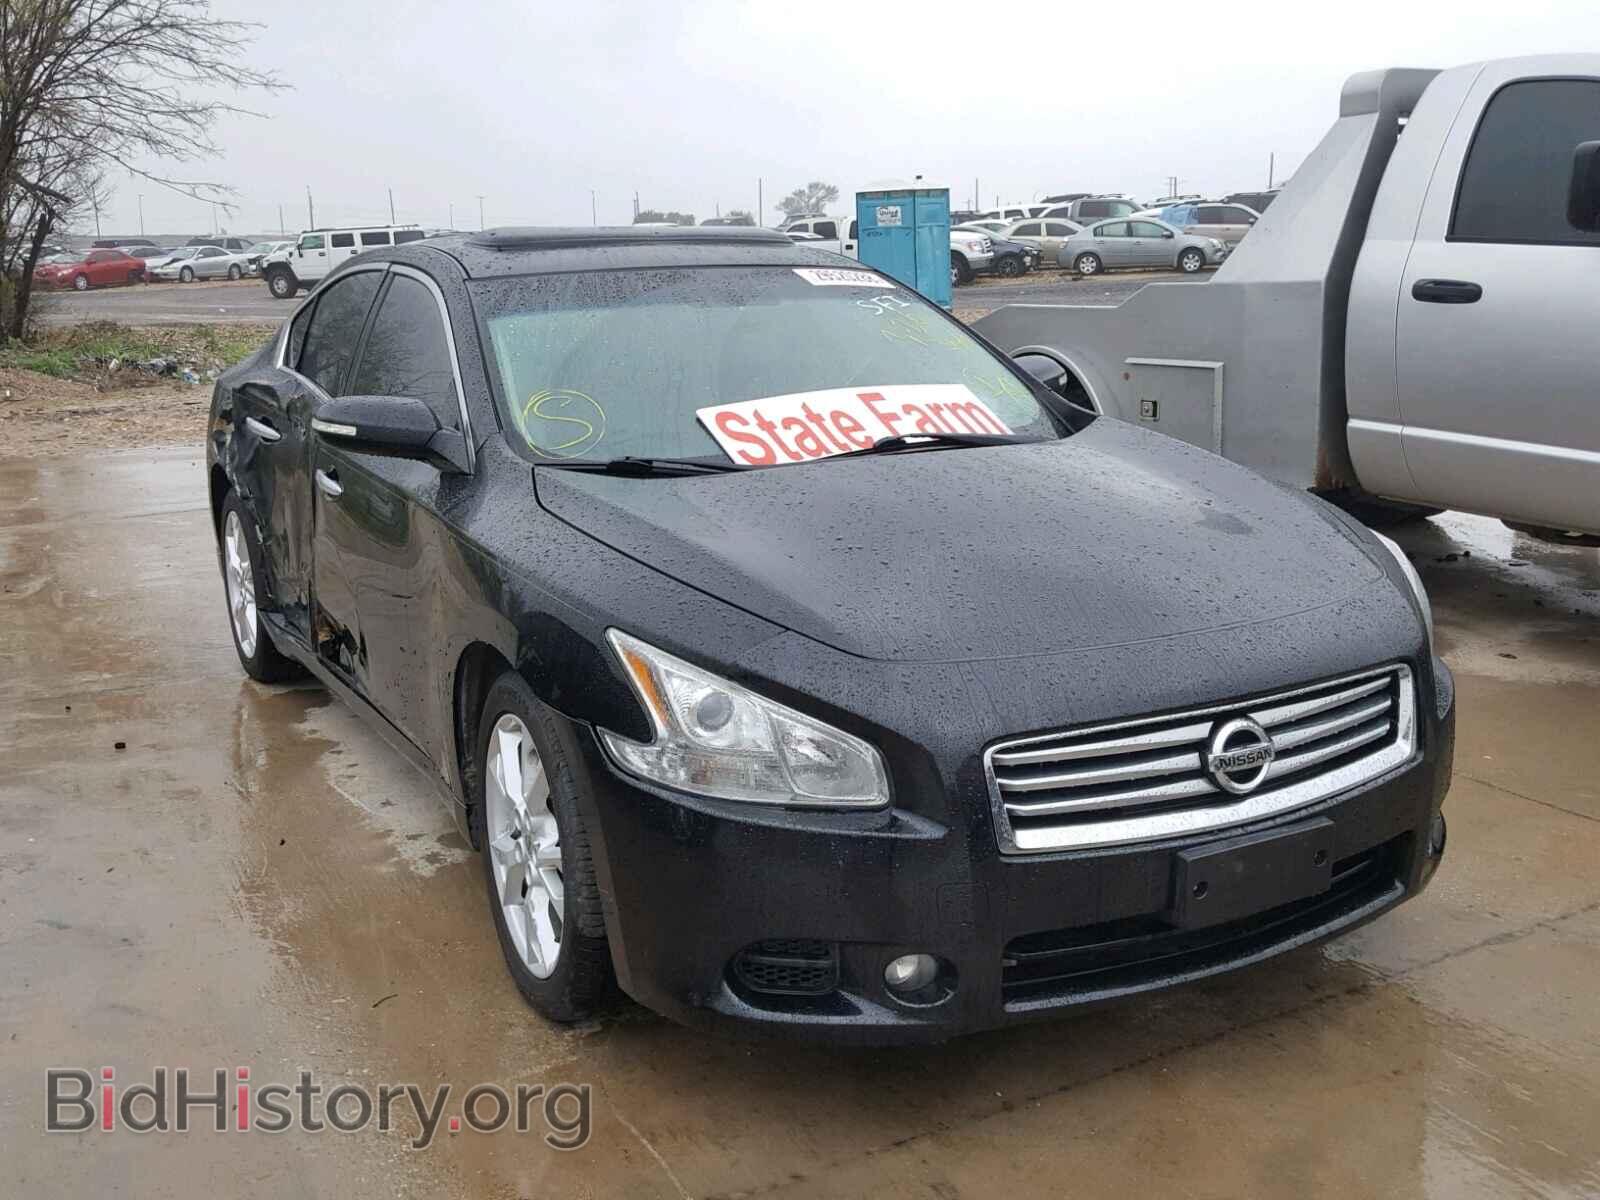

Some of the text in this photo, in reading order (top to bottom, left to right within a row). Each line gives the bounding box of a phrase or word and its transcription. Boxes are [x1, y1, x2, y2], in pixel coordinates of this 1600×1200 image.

[714, 391, 1011, 465] State Farm
[1217, 748, 1273, 768] NISSAN
